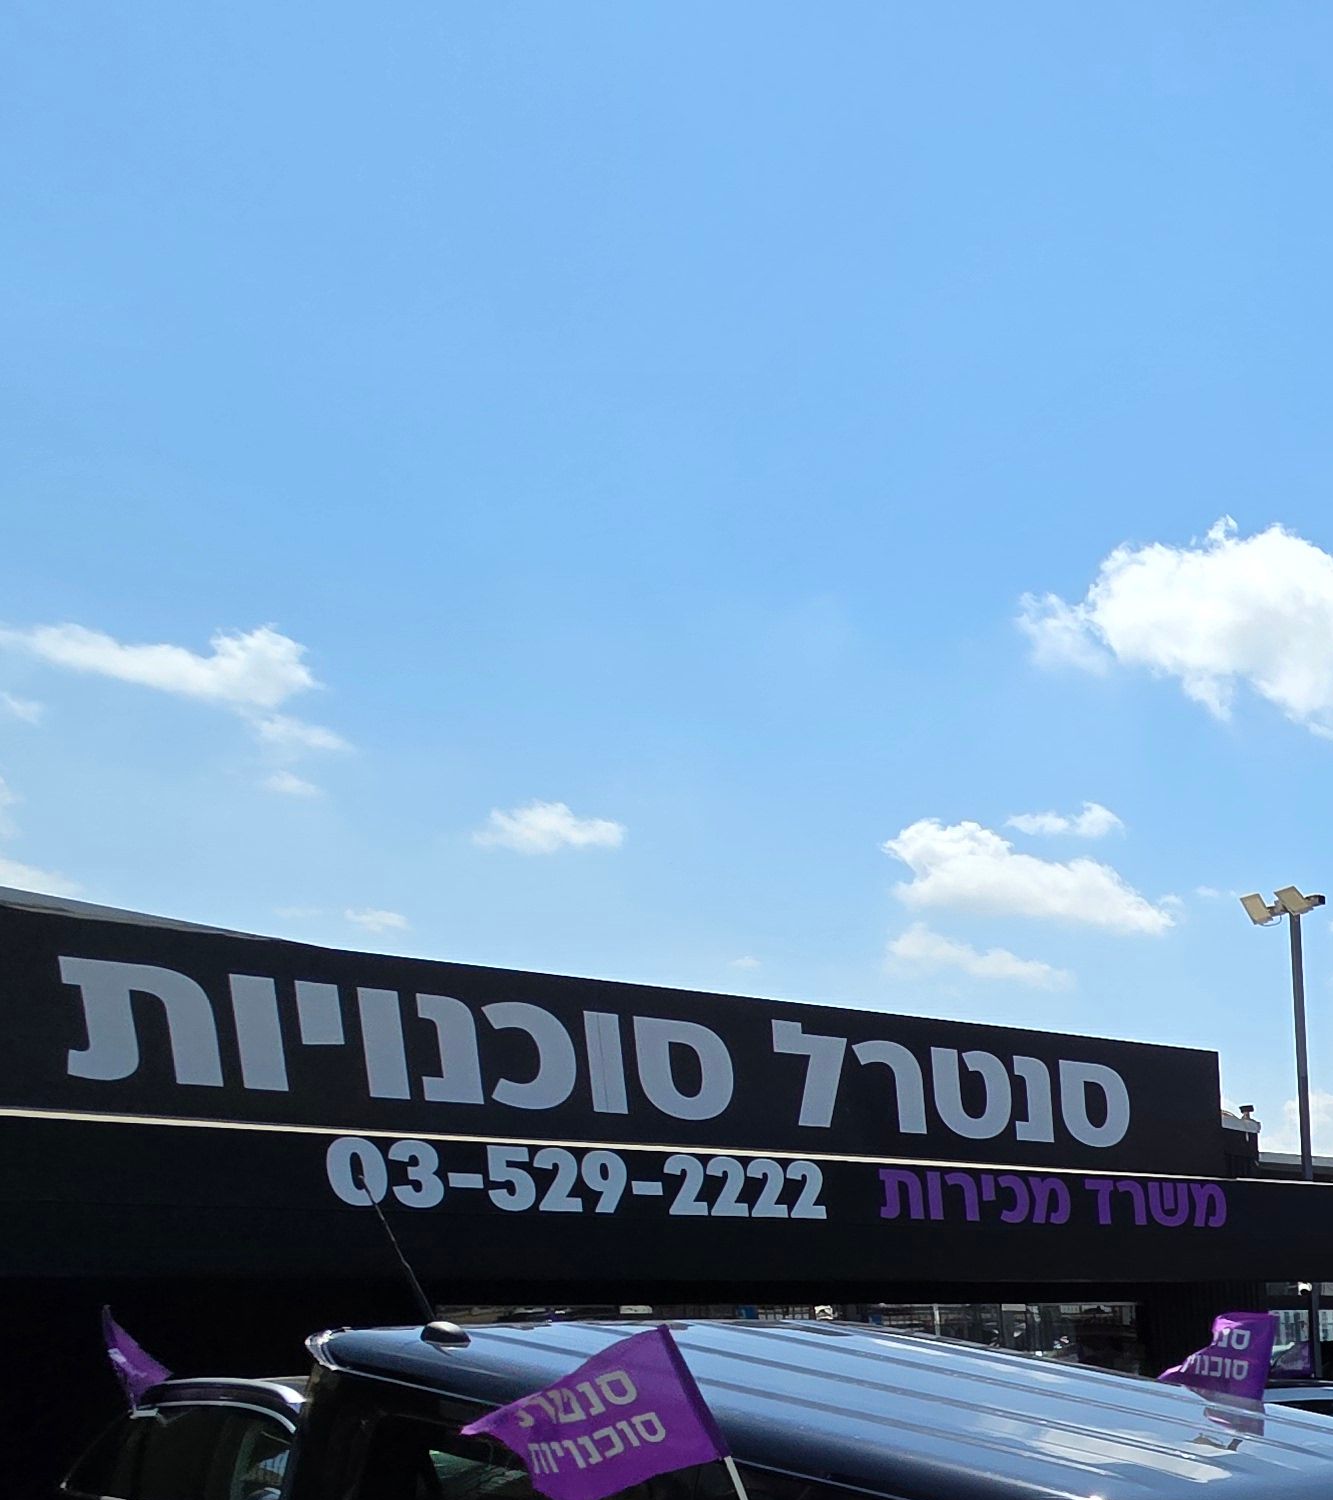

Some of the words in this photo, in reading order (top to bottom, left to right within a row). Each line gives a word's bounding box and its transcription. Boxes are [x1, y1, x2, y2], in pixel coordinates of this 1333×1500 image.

[59, 955, 735, 1121] סוכנויות
[772, 1018, 1131, 1148] סנטרל
[327, 1137, 827, 1219] 03-529-2222
[878, 1162, 1072, 1224] מכירות
[1085, 1172, 1228, 1228] משרד
